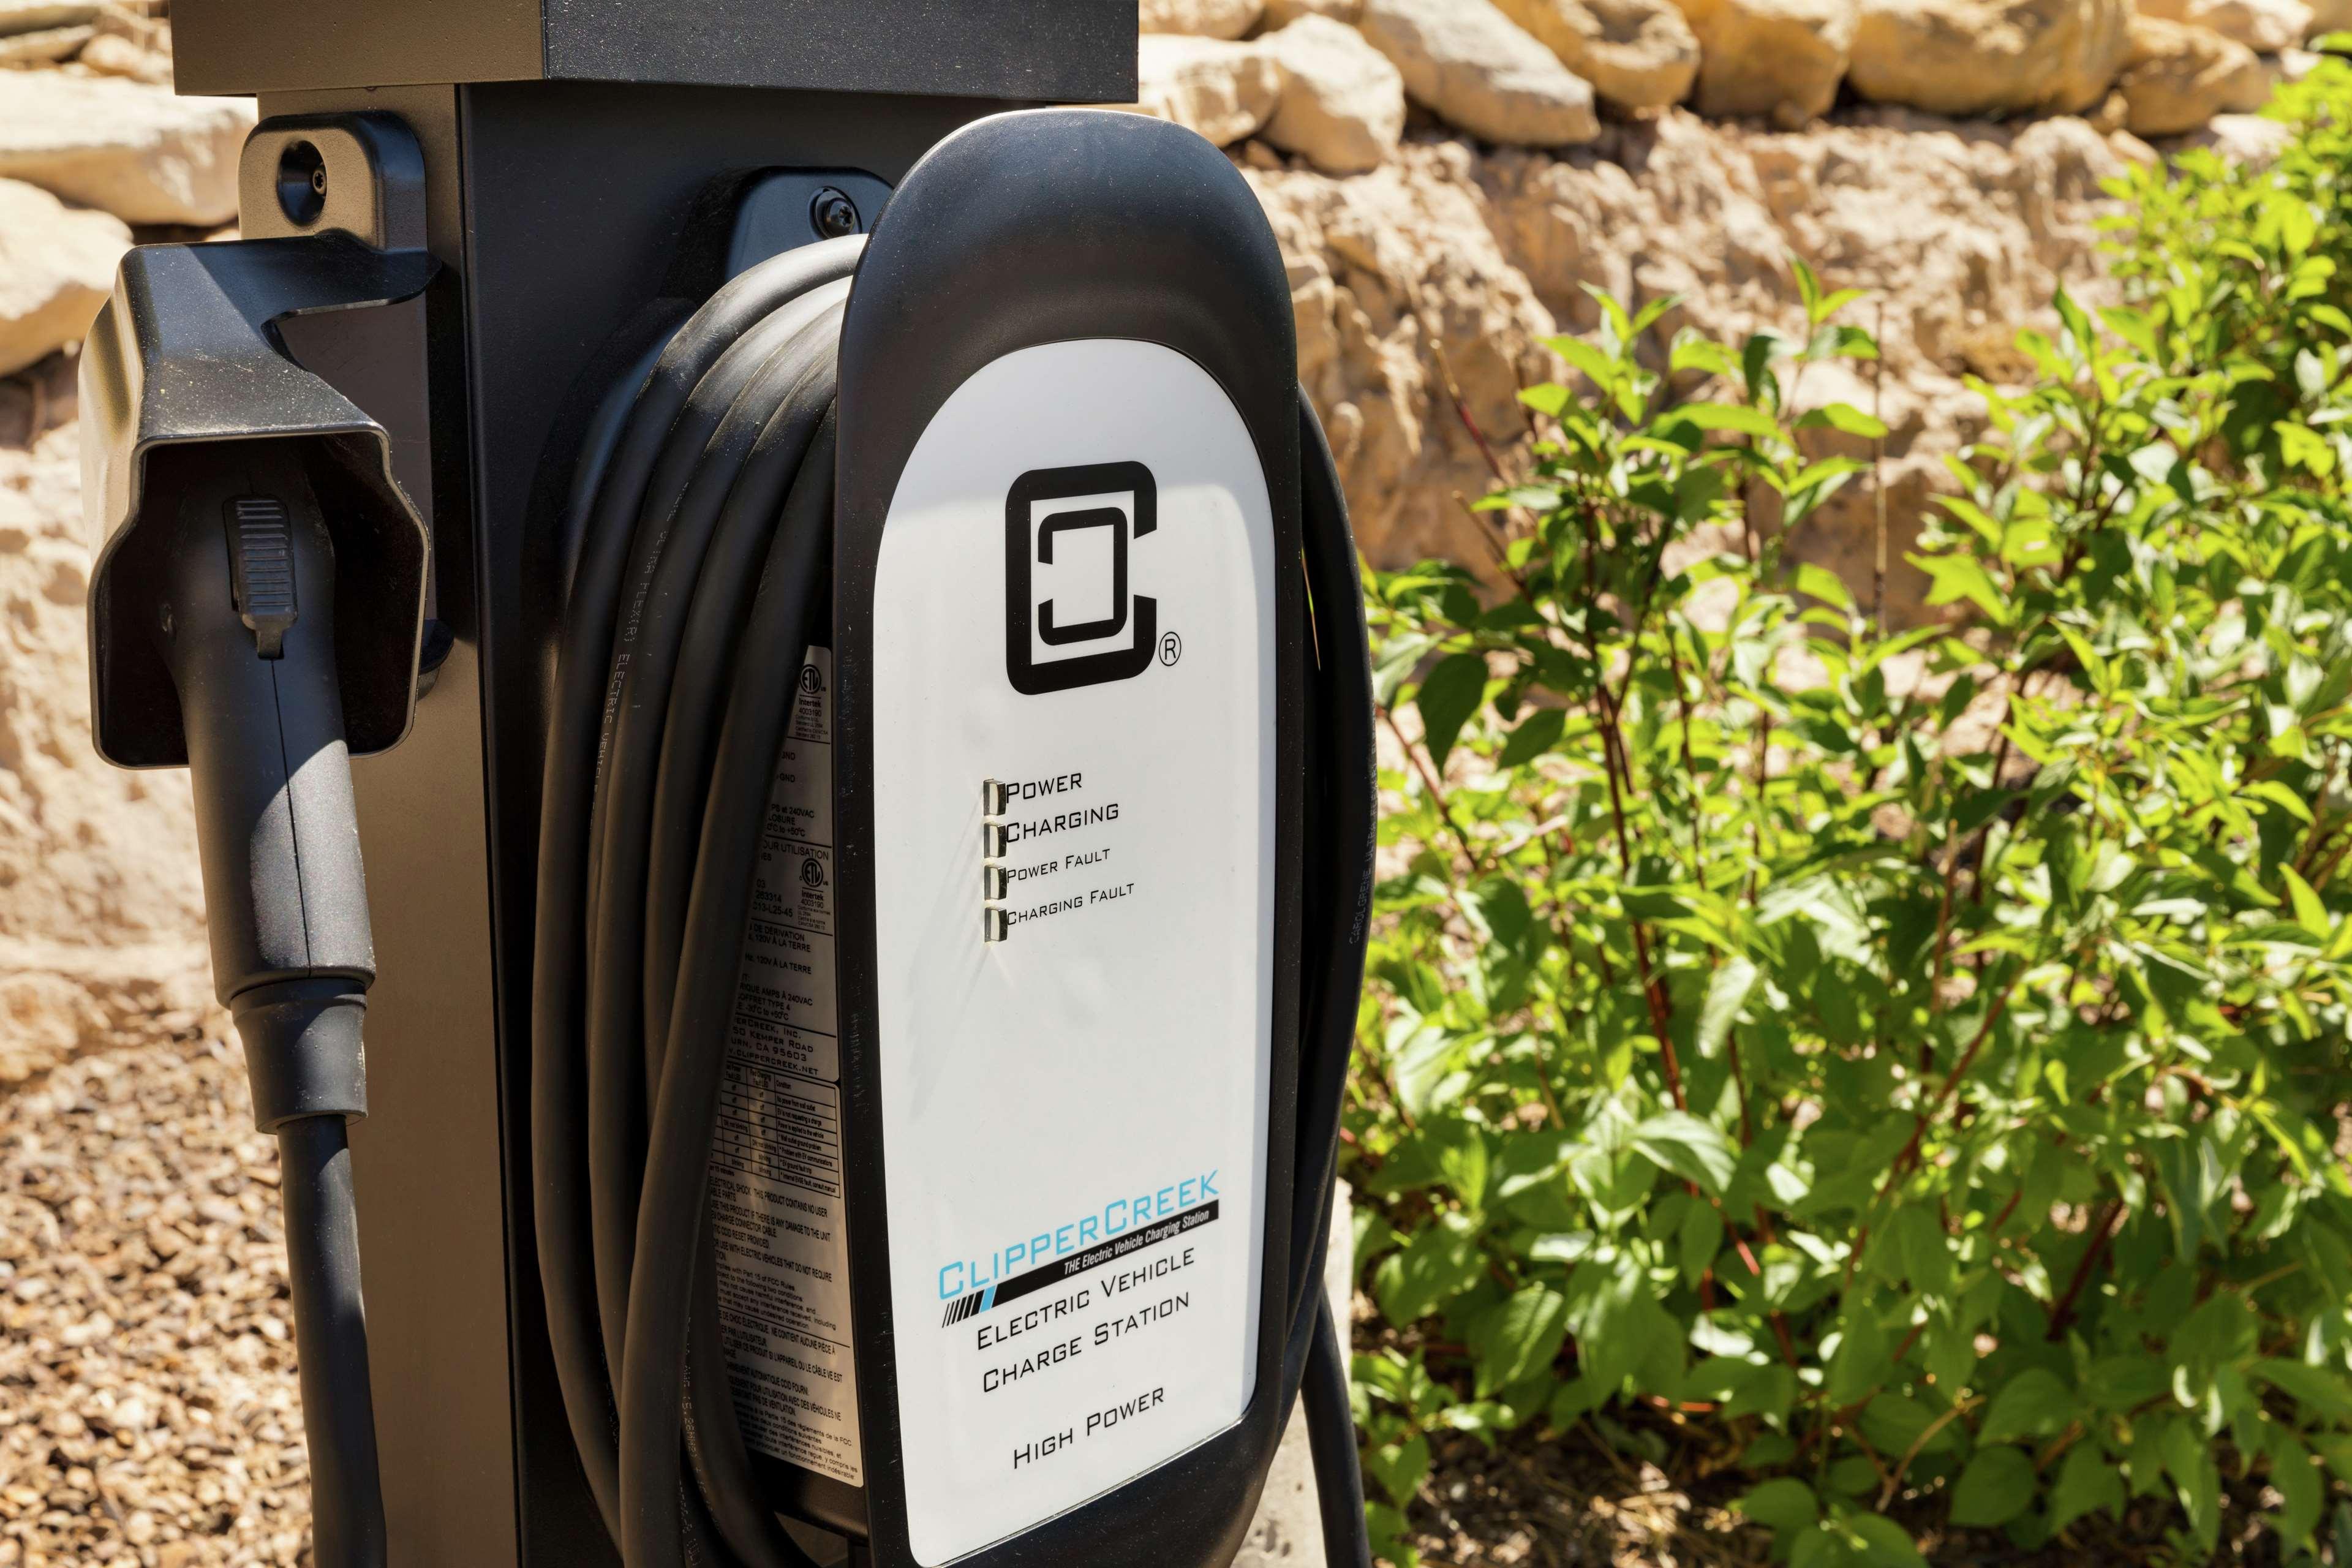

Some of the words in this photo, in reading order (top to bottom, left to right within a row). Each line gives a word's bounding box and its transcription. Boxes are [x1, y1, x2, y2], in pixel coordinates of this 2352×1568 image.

[603, 652, 631, 725] ELECTRIC
[779, 772, 795, 783] GND
[1006, 772, 1082, 804] POWER
[789, 805, 814, 819] 240VAC
[1006, 803, 1118, 843] CHARGING
[781, 842, 829, 861] UTILISATION
[1007, 861, 1058, 883] POWER
[1065, 848, 1110, 869] FAULT
[1007, 896, 1083, 925] CHARGING
[1090, 883, 1134, 904] FAULT
[778, 937, 786, 948] LA
[788, 940, 811, 953] TERRE
[779, 959, 788, 970] LA
[789, 961, 812, 974] TERRE
[761, 986, 780, 999] AMPS
[788, 992, 813, 1007] 240VAC
[767, 998, 784, 1010] TYPE
[749, 1029, 784, 1046] KEMPER
[788, 1038, 813, 1054] ROAD
[783, 1026, 801, 1039] INC.
[755, 1041, 769, 1053] CA
[772, 1045, 807, 1062] 95603
[754, 1188, 764, 1200] THIS
[764, 1190, 785, 1207] PRODUCT
[786, 1196, 807, 1213] CONTAINS
[808, 1202, 815, 1215] NO
[815, 1205, 827, 1218] USER
[717, 1211, 734, 1226] CHARGE
[735, 1216, 762, 1234] CONNECTOR
[720, 1201, 729, 1213] THIS
[729, 1204, 750, 1219] PRODUCT
[755, 1211, 770, 1225] THERE
[775, 1217, 785, 1229] ANY
[785, 1219, 804, 1235] DAMAGE
[804, 1225, 810, 1237] TO
[810, 1227, 820, 1239] THE
[820, 1230, 831, 1243] UNIT
[733, 1229, 747, 1243] RESET
[939, 1169, 1219, 1300] CLIPPERCREEK
[1064, 1261, 1080, 1275] THE
[1082, 1247, 1112, 1268] Electric
[1115, 1235, 1144, 1256] Vehicle
[1145, 1221, 1181, 1243] Charging
[1182, 1209, 1210, 1229] Station
[720, 1240, 729, 1252] USE
[741, 1246, 761, 1262] ELECTRIC
[762, 1252, 783, 1268] VEHICLES
[784, 1259, 795, 1272] THAT
[795, 1262, 802, 1274] DO
[802, 1264, 812, 1277] NOT
[812, 1267, 832, 1283] REQUIRE
[767, 1276, 780, 1287] FCC
[978, 1290, 1090, 1351] ELECTRIC
[1101, 1248, 1195, 1298] VEHICLE
[805, 1306, 816, 1316] and
[813, 1317, 836, 1332] including
[778, 1328, 799, 1344] CONTIENT
[800, 1335, 817, 1350] AUCUNE
[983, 1336, 1082, 1393] CHARGE
[1094, 1292, 1189, 1345] STATION
[834, 1371, 843, 1384] EST
[788, 1393, 799, 1407] AVEC
[801, 1398, 809, 1411] DES
[835, 1409, 842, 1422] NE
[1014, 1428, 1073, 1469] HIGH
[1087, 1387, 1164, 1436] POWER
[840, 1436, 853, 1449] FCC
